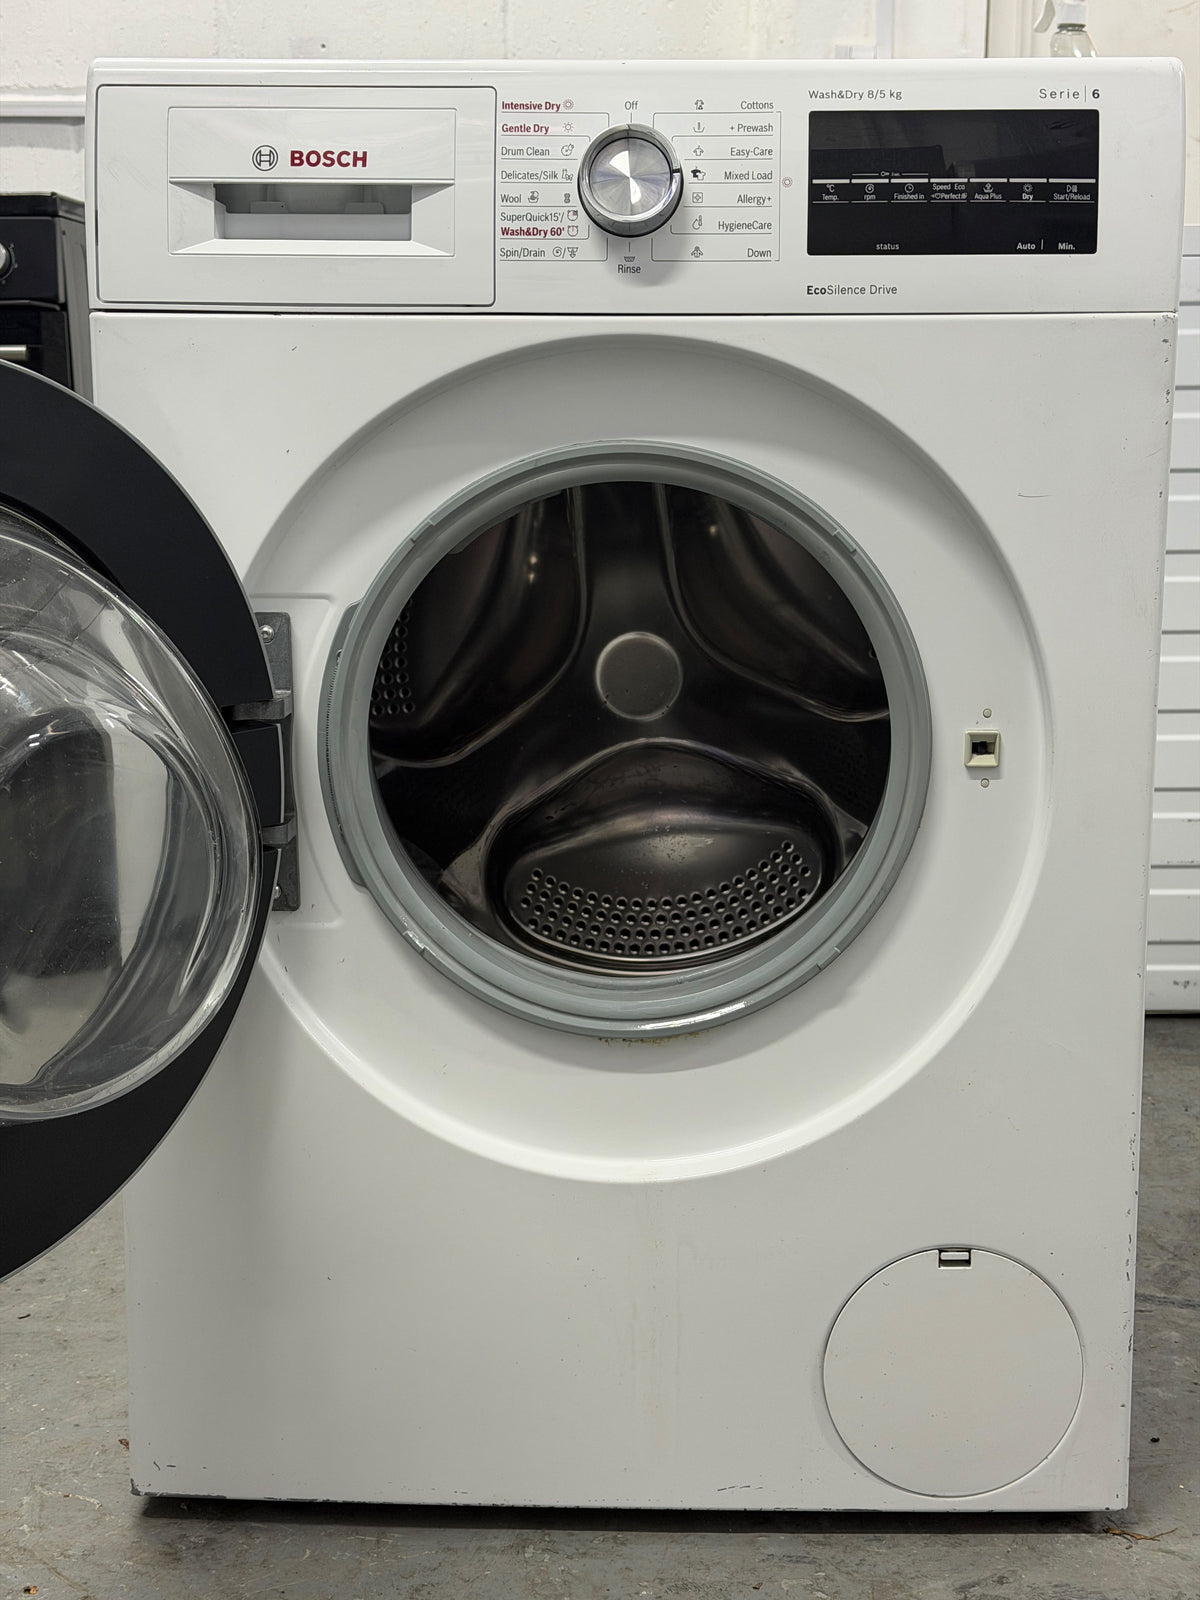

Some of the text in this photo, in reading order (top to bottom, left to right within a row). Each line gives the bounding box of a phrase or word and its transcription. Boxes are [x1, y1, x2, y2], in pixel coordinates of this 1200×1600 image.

[808, 89, 903, 101] Wash&Dry 8/5 kg
[1038, 88, 1101, 100] Serie 6
[502, 100, 561, 113] Intensive Dry
[624, 100, 638, 110] Off
[740, 100, 774, 110] Cottons
[502, 124, 550, 135] Gentle Dry
[737, 122, 774, 132] Prewash
[500, 146, 550, 156] Drum Clean
[730, 146, 774, 158] Easy-Care
[290, 150, 368, 168] BOSCH
[500, 170, 559, 180] Delicates/Silk
[724, 170, 773, 180] Mixed Load
[500, 194, 522, 204] Wool
[736, 194, 772, 206] Allergy+
[974, 192, 989, 200] Aqua
[1022, 193, 1034, 201] Dry
[1053, 192, 1091, 200] Start/Reload
[718, 220, 772, 232] HygieneCare
[500, 226, 548, 238] Wash&Dry
[1016, 242, 1036, 250] Auto
[1058, 242, 1076, 250] Min.
[500, 247, 546, 258] Spin/Drain
[747, 248, 772, 258] Down
[618, 264, 641, 274] Rinse
[806, 284, 898, 296] EcoSilence Drive
